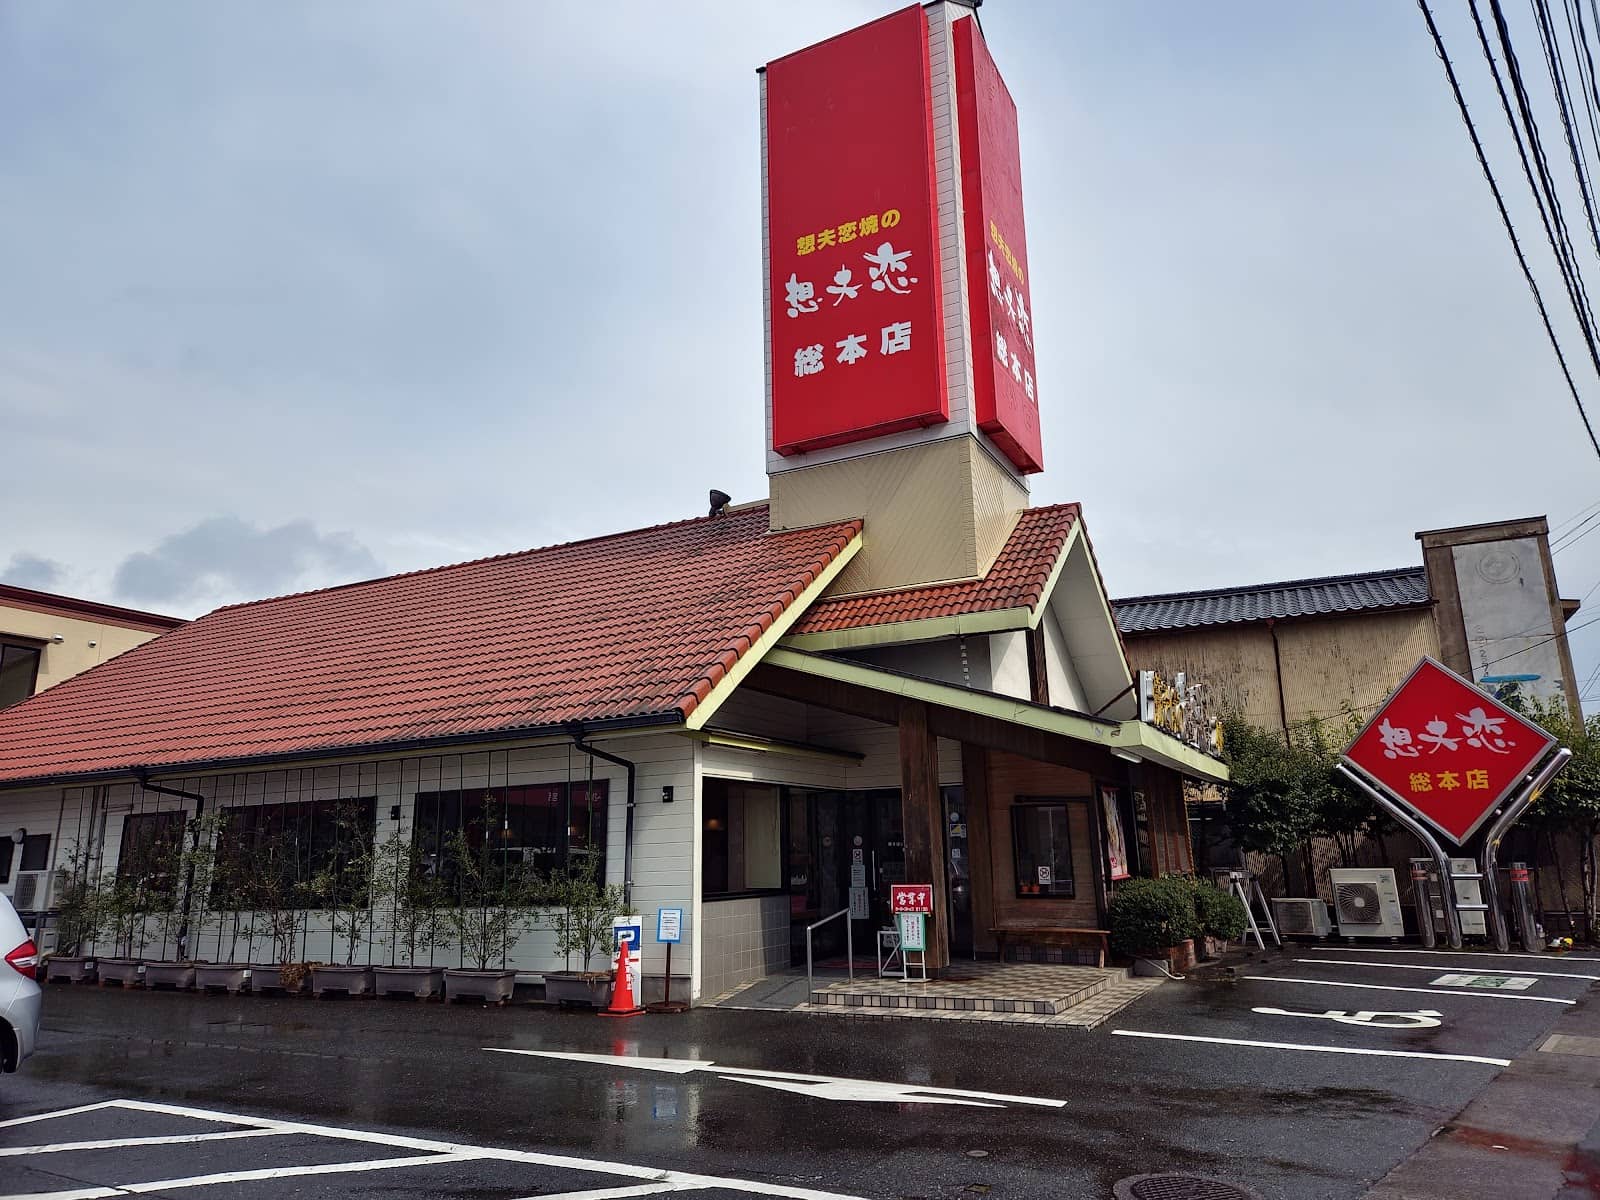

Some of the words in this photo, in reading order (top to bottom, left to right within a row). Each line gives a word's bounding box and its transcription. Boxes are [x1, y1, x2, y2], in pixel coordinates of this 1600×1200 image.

[796, 209, 901, 256] 想夫恋焼の
[785, 242, 918, 318] 想夫恋
[794, 320, 912, 378] 総本店
[996, 331, 1034, 403] 総本店
[1377, 706, 1517, 760] 想夫恋
[1409, 769, 1489, 793] 総本店
[896, 891, 926, 906] 営業中
[617, 930, 635, 949] P
